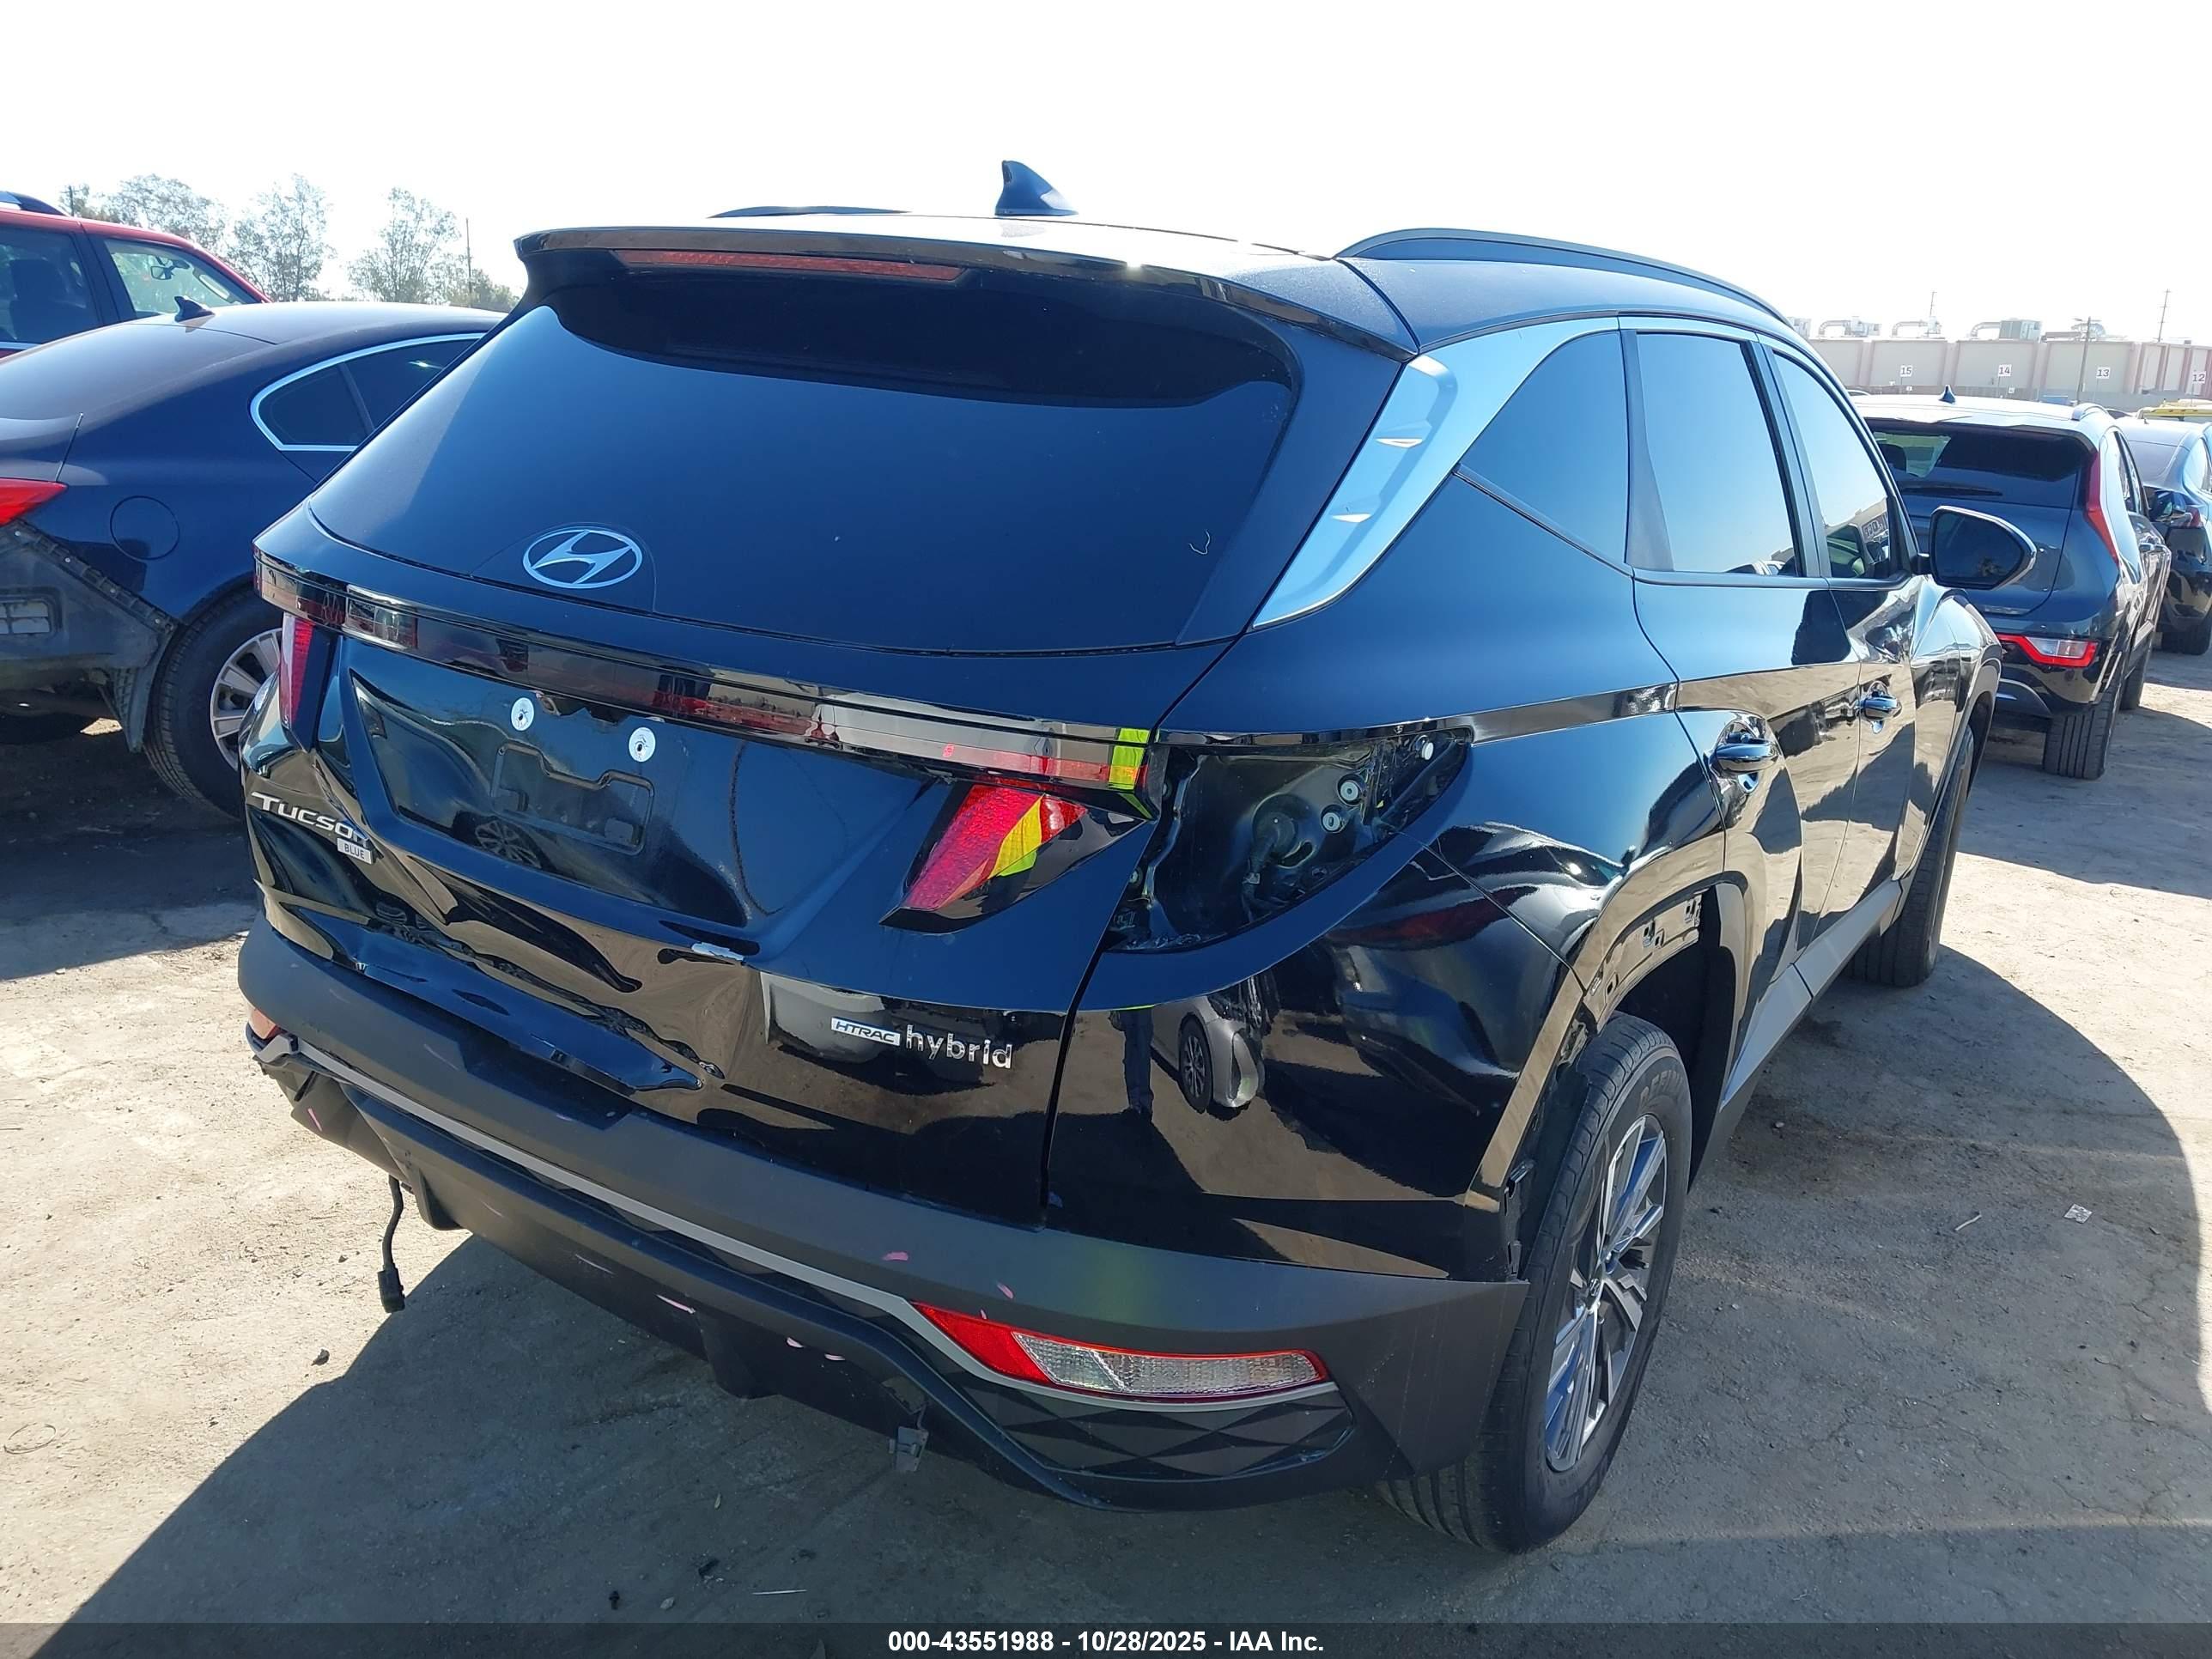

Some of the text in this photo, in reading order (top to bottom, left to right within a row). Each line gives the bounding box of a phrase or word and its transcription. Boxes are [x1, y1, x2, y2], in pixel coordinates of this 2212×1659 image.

[1900, 367, 1912, 375] 15
[1998, 366, 2010, 374] 14
[2096, 368, 2110, 377] 13
[2192, 374, 2205, 382] 12
[251, 791, 370, 848] TUCSON
[343, 842, 366, 860] BLUE
[836, 1020, 1012, 1070] HTRAC hybrid
